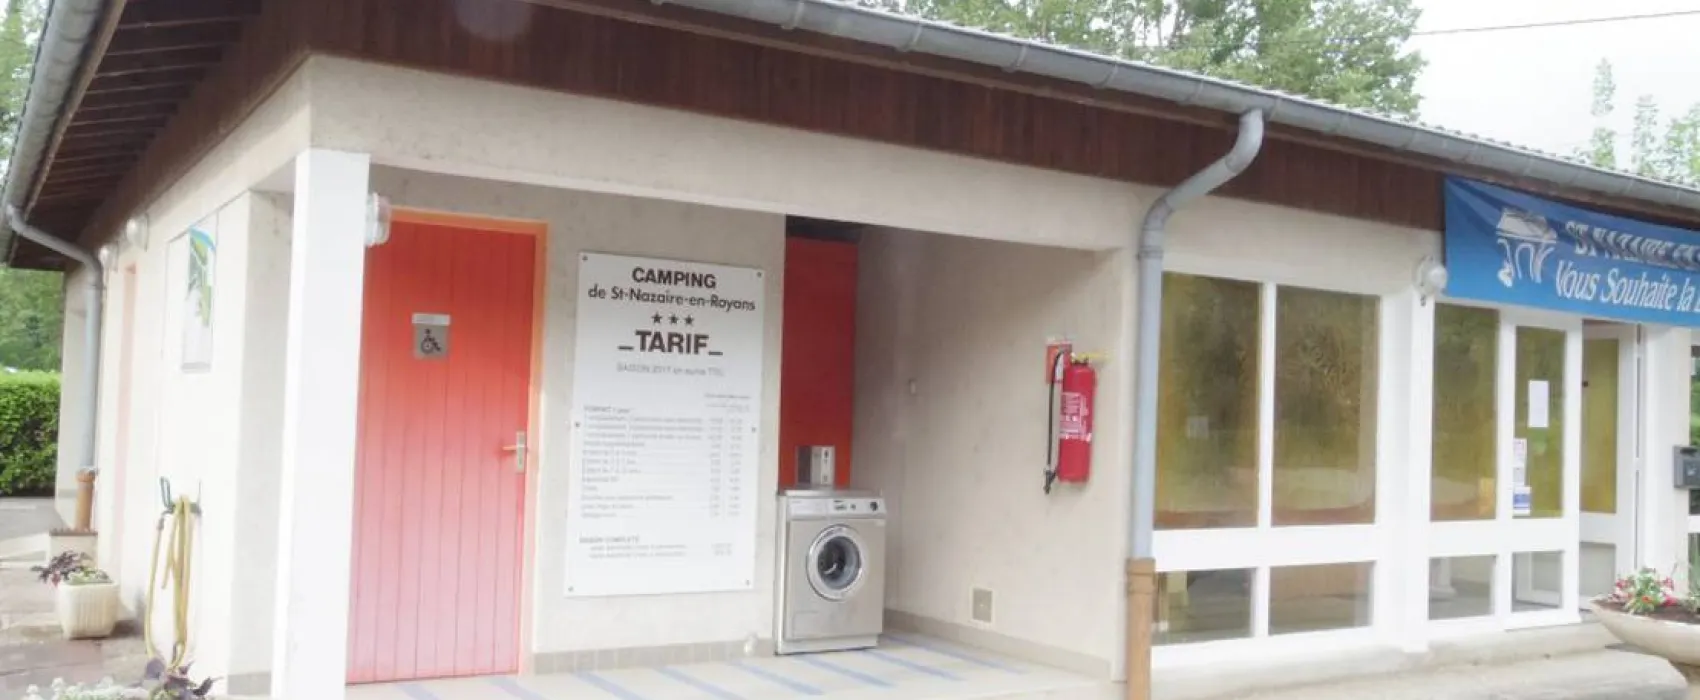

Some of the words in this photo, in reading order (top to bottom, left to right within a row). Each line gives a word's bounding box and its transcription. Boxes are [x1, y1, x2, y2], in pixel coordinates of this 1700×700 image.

[632, 267, 717, 289] CAMPING
[1557, 260, 1600, 301] Vous
[1601, 268, 1676, 310] Souhaite
[1677, 277, 1696, 312] la
[588, 284, 606, 299] de
[611, 286, 756, 312] St-Nazaire-en-Royans
